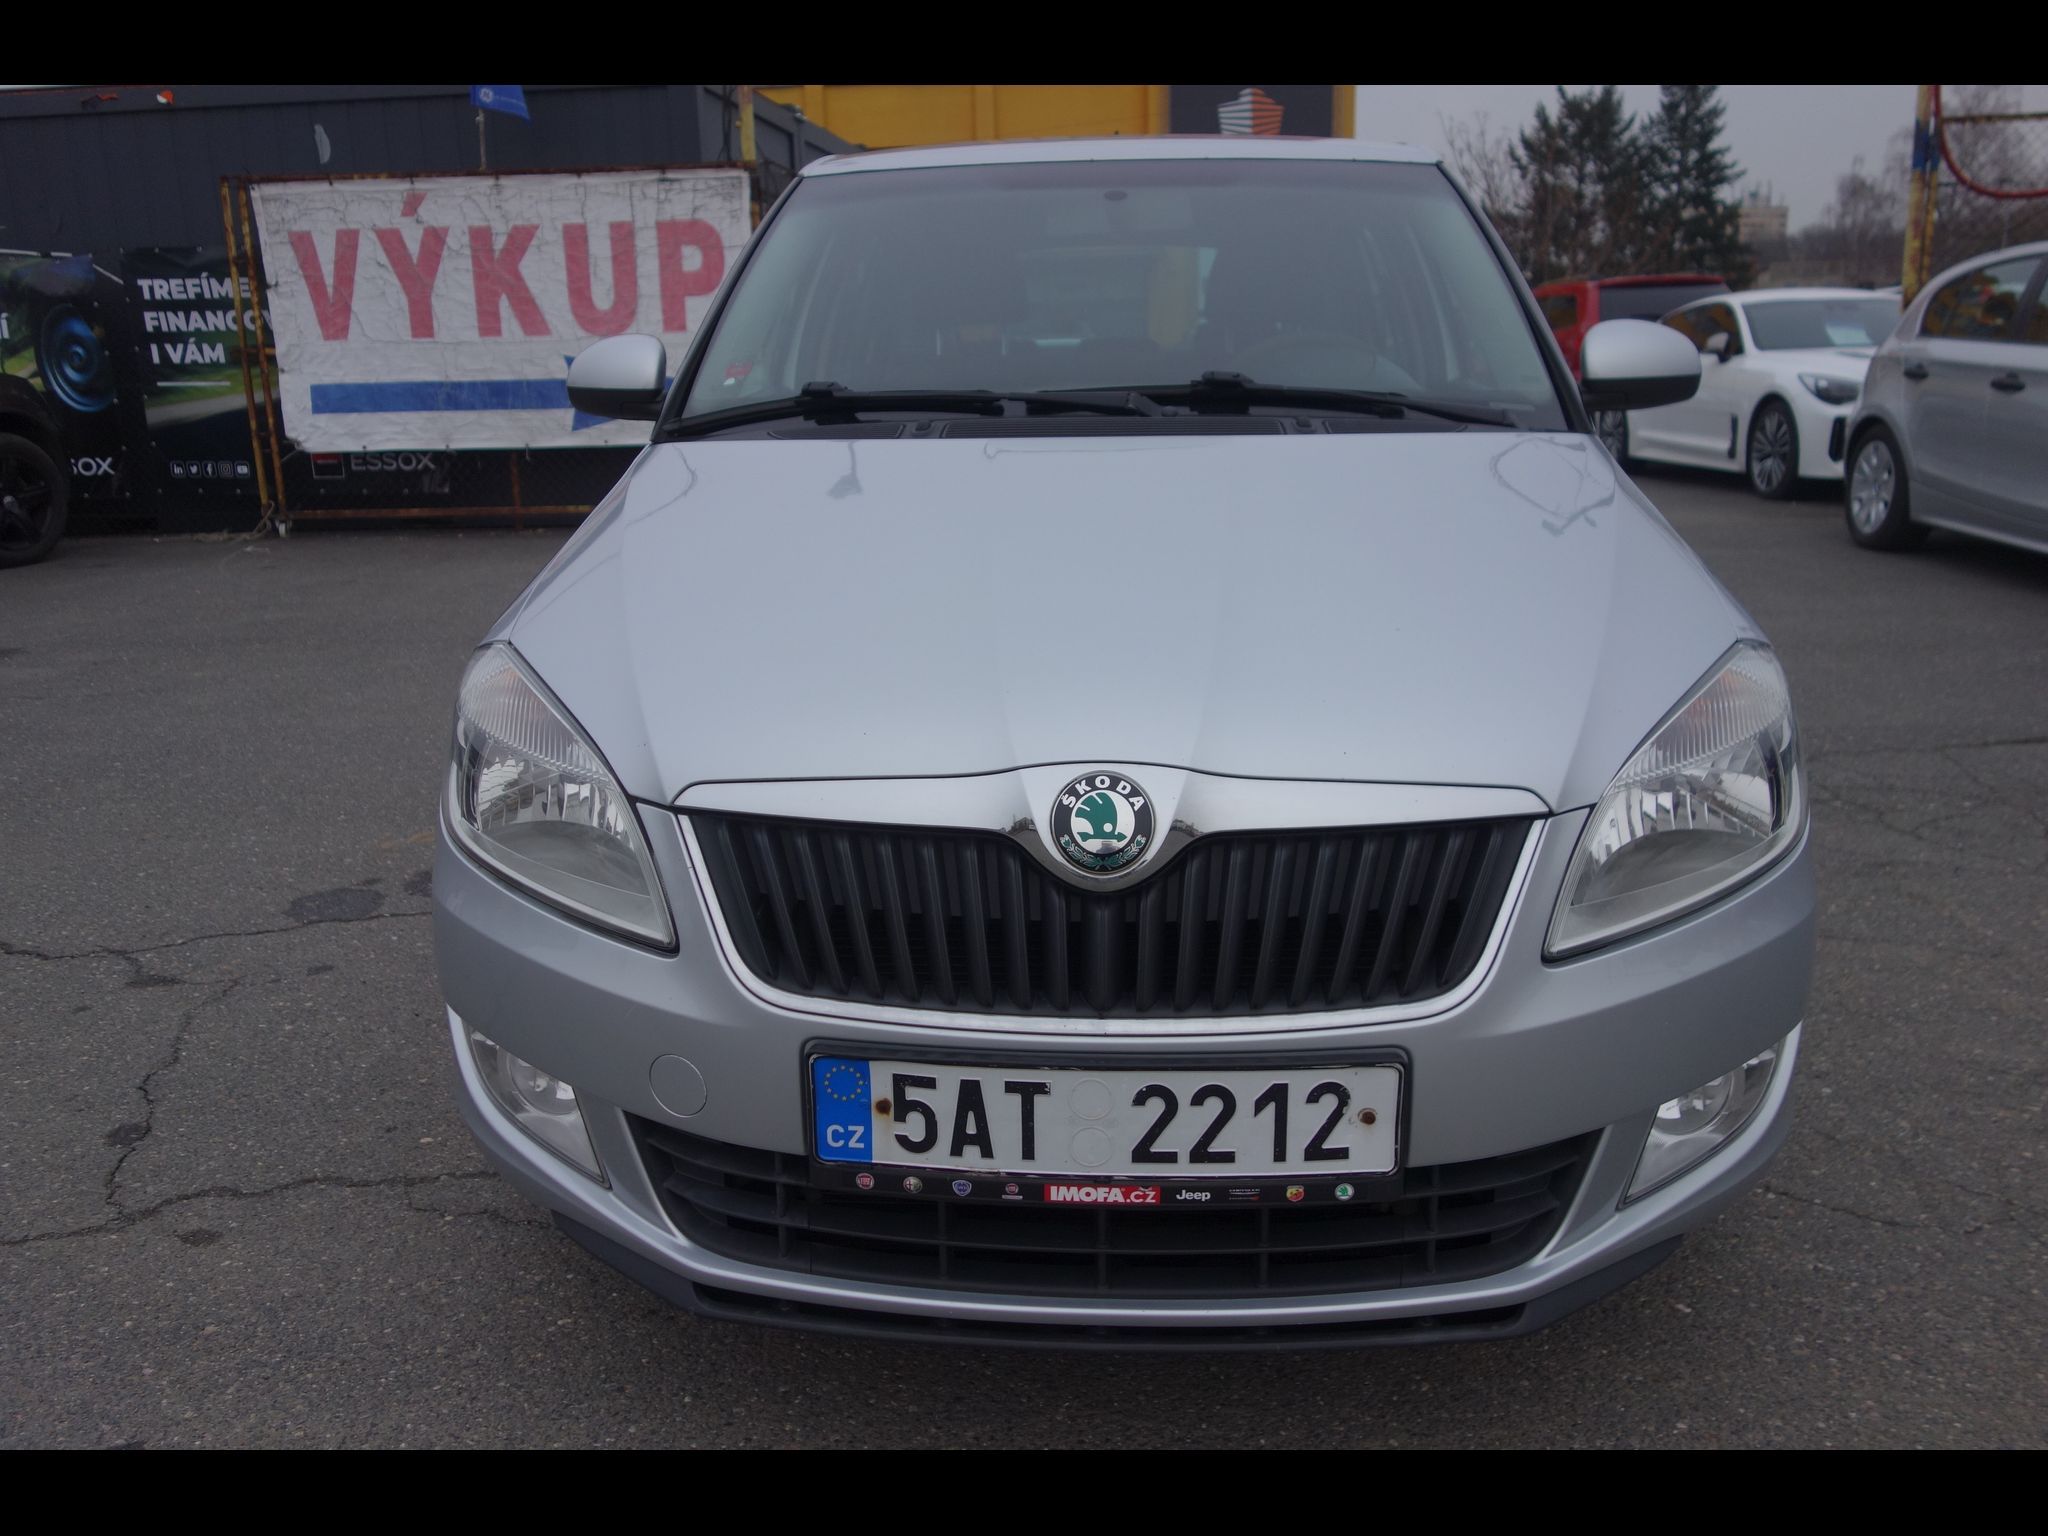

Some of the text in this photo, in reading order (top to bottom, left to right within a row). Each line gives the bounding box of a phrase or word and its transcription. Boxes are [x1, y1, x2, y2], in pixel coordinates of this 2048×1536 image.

[288, 192, 725, 341] VÝKUP
[137, 272, 251, 299] TREFÍME
[150, 337, 226, 365] I VÁM
[350, 452, 436, 471] ESSOX
[1060, 775, 1146, 812] ŠKODA
[891, 1073, 1351, 1164] 5AT 2212
[826, 1124, 866, 1149] CZ
[1176, 1189, 1211, 1202] Jeep
